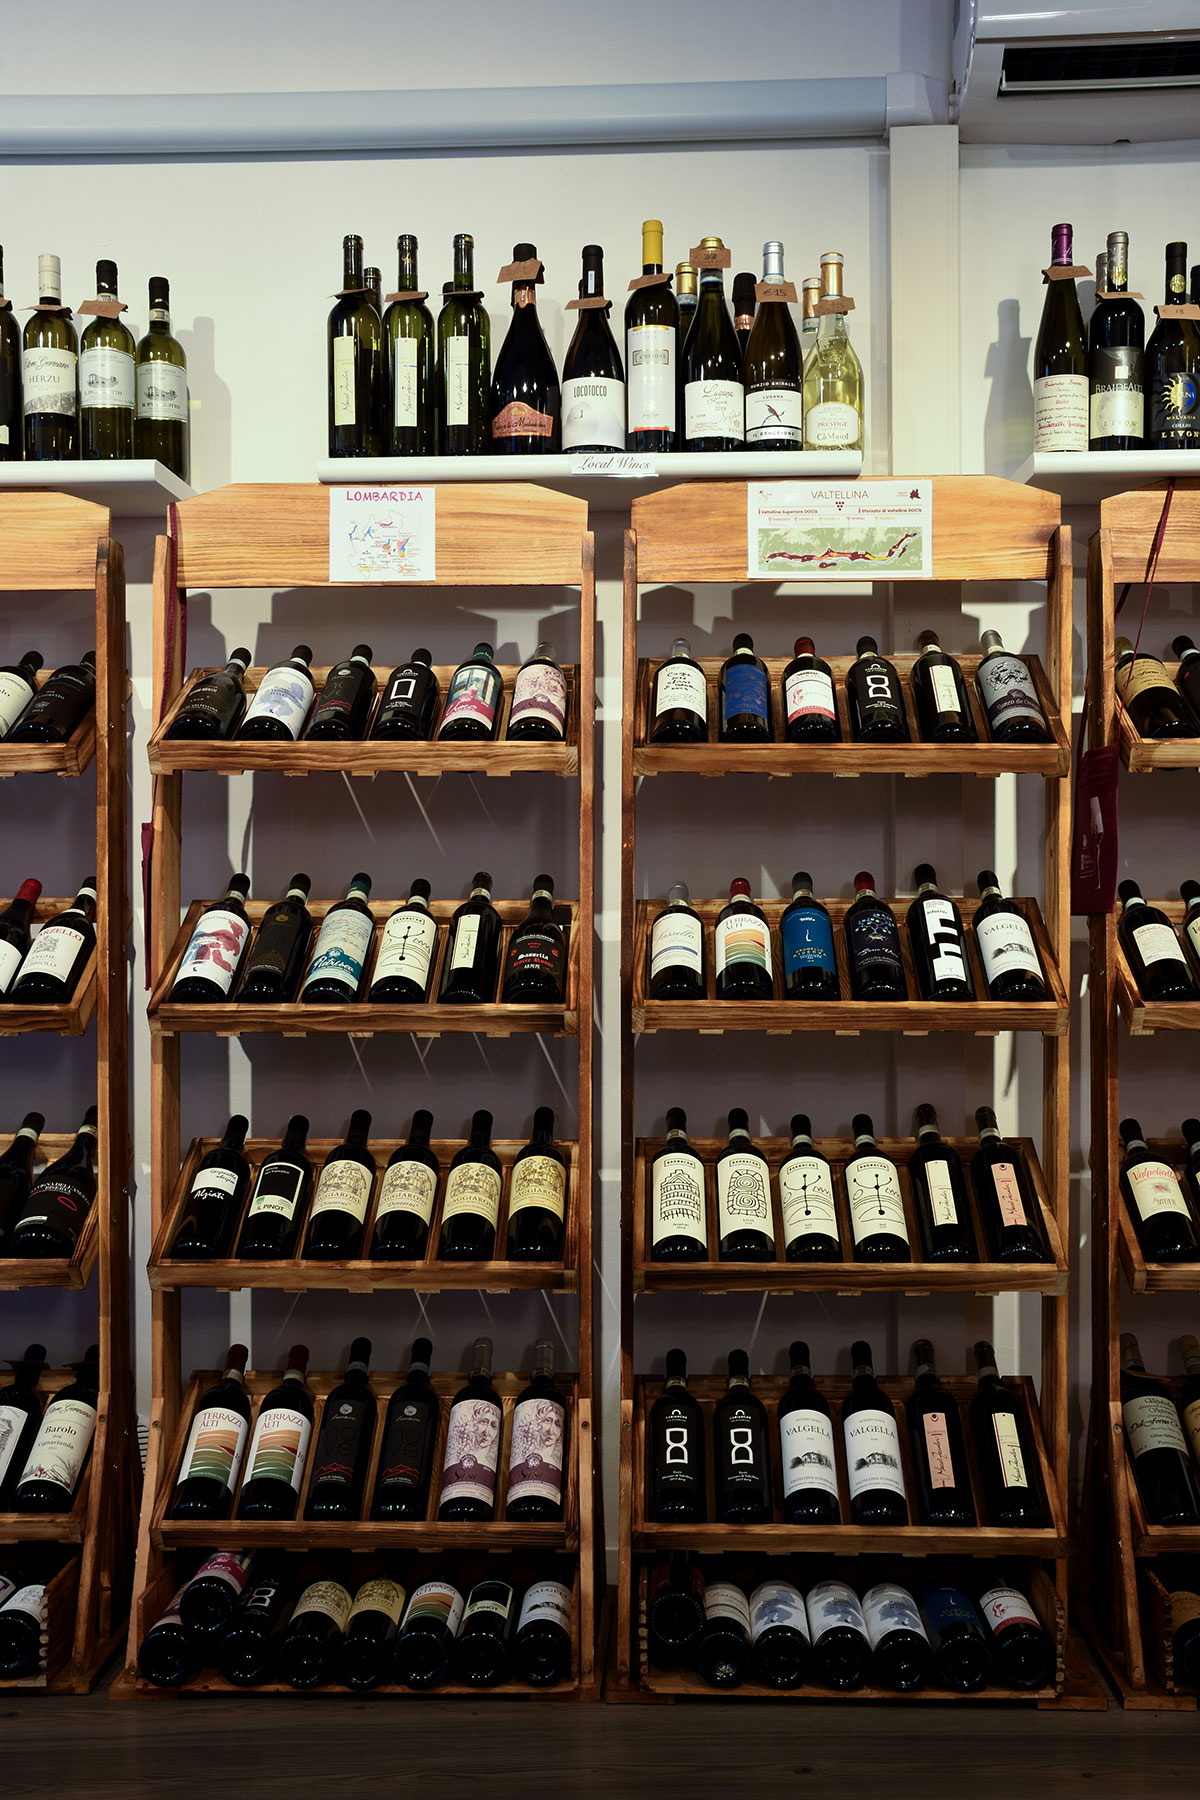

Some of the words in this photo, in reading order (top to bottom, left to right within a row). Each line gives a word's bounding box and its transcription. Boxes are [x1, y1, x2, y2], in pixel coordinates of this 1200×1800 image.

[573, 385, 608, 398] LOCOTOCCO
[578, 456, 614, 471] Local
[616, 456, 651, 470] Wines
[346, 491, 424, 502] LOMBARDIA
[811, 490, 869, 500] VALTELLINA
[262, 1203, 285, 1212] PINOT
[200, 1420, 219, 1428] ALTI
[202, 1412, 242, 1428] TERRAZZI
[262, 1421, 280, 1430] ALTI
[264, 1414, 303, 1428] TERRAZZI
[45, 1425, 77, 1436] Barolo
[786, 1425, 831, 1440] VALGELLA
[849, 1425, 896, 1439] VALGELLA
